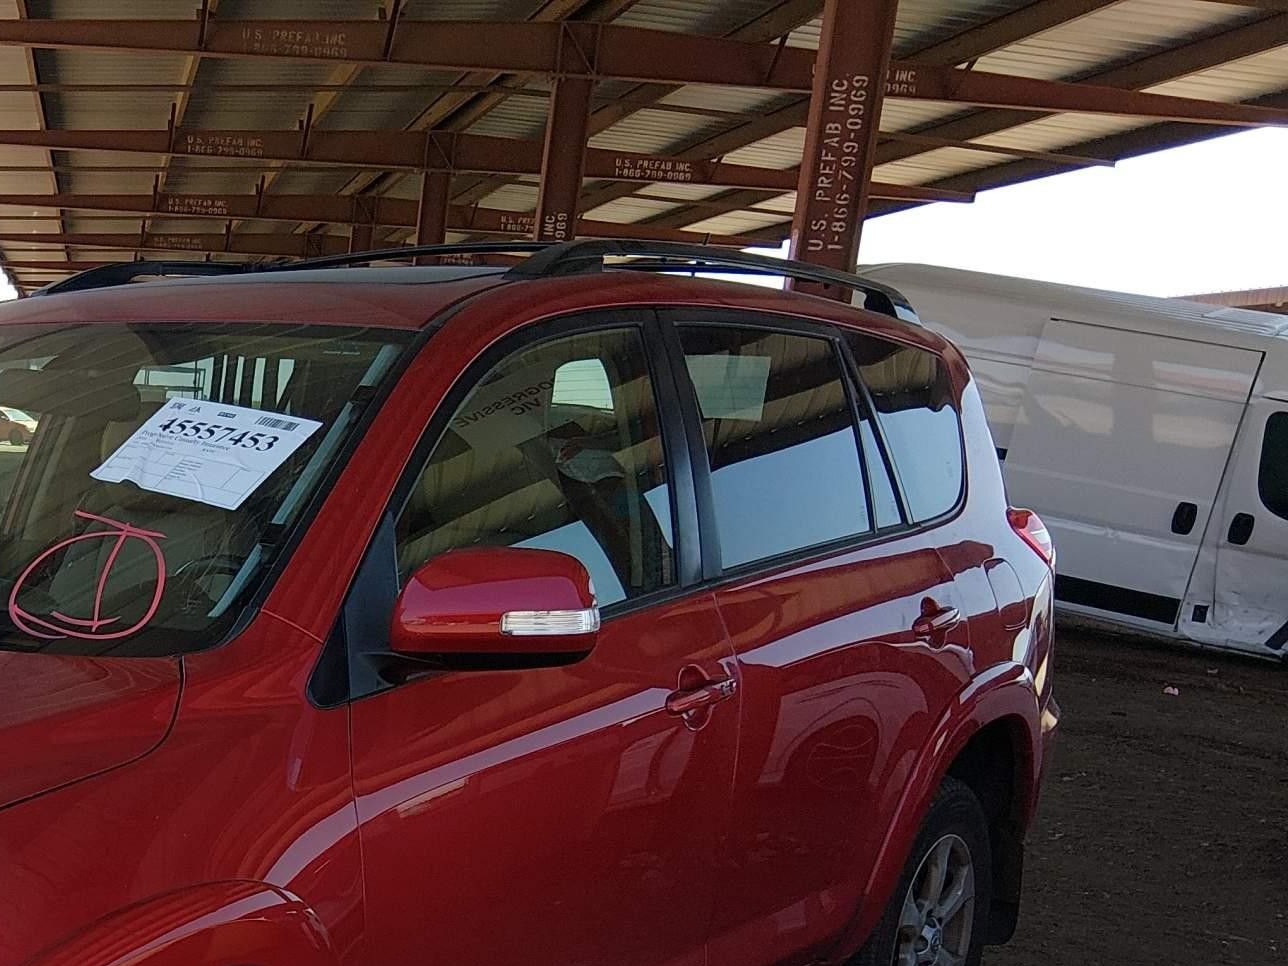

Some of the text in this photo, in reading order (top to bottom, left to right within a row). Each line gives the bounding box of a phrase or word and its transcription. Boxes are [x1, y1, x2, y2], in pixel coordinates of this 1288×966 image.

[815, 122, 843, 201] PREFAB
[827, 75, 869, 250] 1-866-799-0969
[554, 212, 568, 242] 969
[808, 212, 828, 251] U.S.
[159, 417, 280, 451] 45557453
